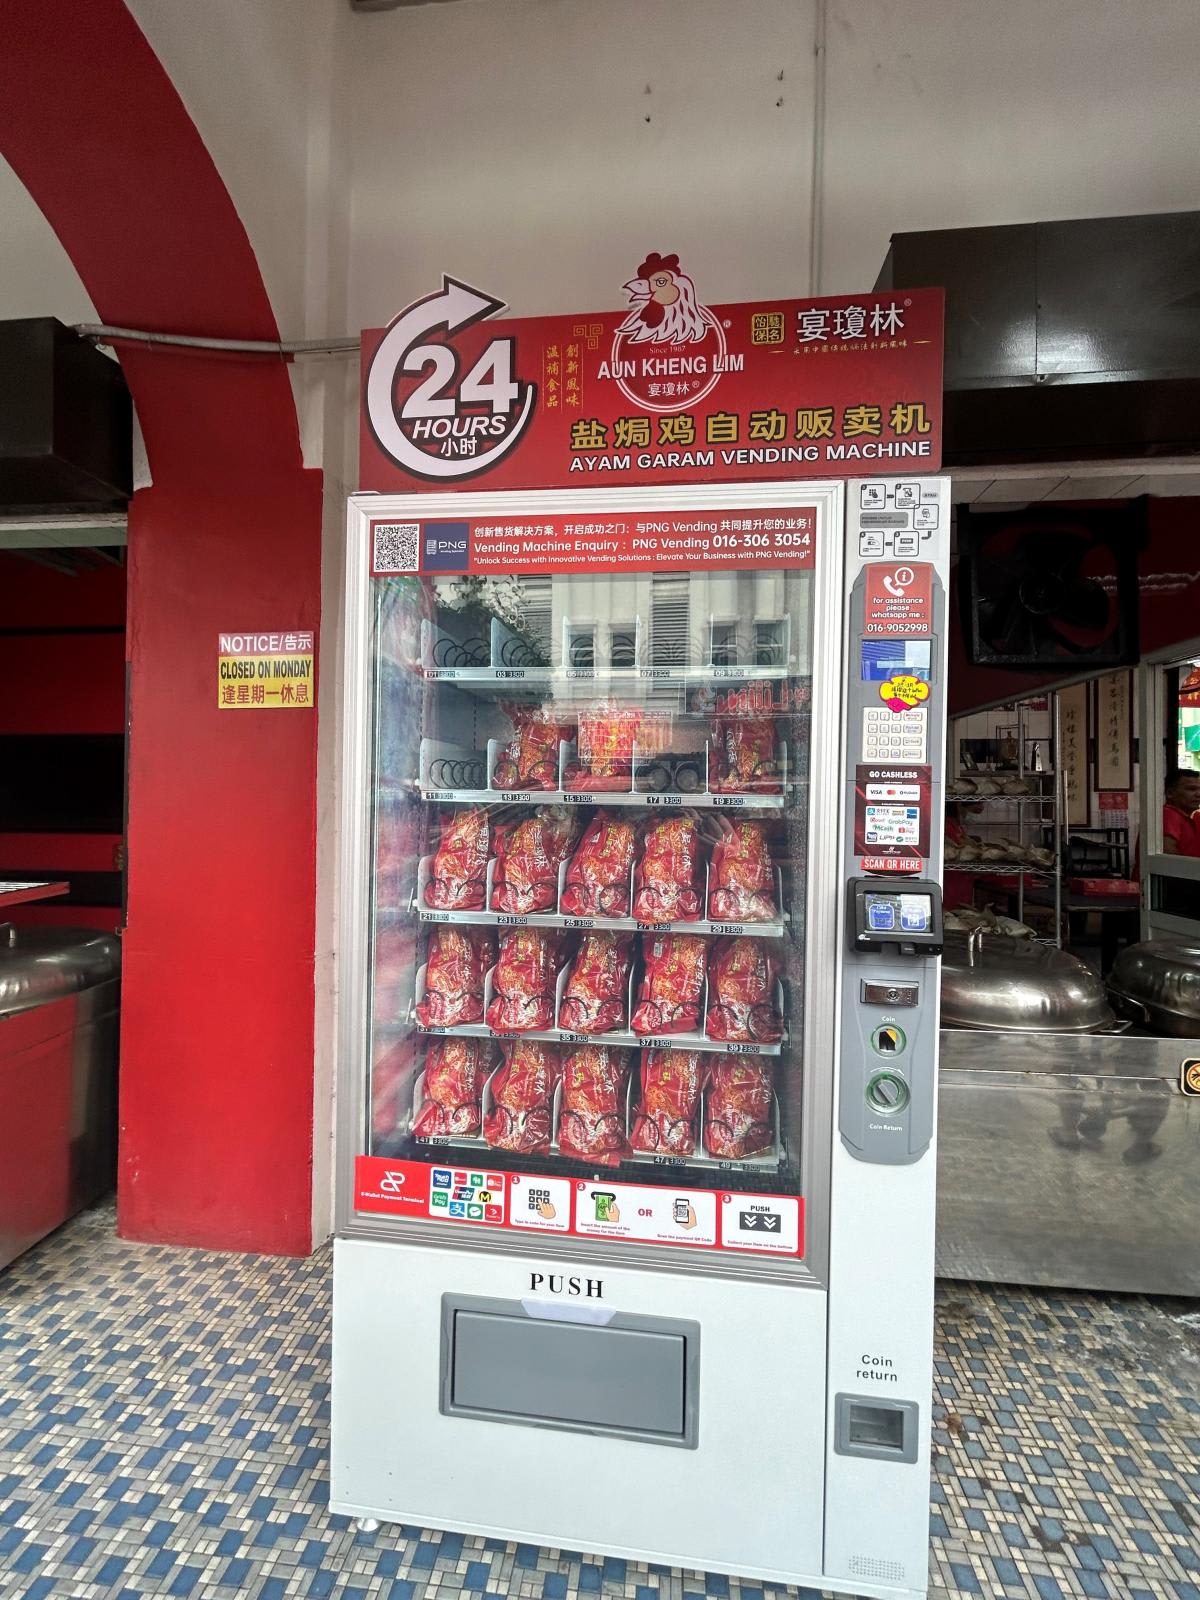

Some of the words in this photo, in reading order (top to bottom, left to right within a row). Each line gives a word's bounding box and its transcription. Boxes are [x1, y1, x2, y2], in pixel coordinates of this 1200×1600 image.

[597, 358, 636, 379] AUN
[641, 355, 707, 376] KHENG
[713, 354, 744, 372] LIM
[401, 340, 519, 419] 24
[412, 416, 507, 440] HOURS
[569, 403, 932, 451] 盐焗鸡自动贩卖机
[439, 437, 478, 456] 小时
[569, 455, 630, 473] AYAM
[636, 451, 715, 469] GARAM
[720, 445, 819, 464] VENDING
[825, 441, 931, 460] MACHINE
[672, 522, 718, 533] Vending
[439, 541, 467, 549] PNG
[474, 543, 520, 555] Vending
[523, 541, 571, 553] Machine
[574, 540, 619, 552] Enquiry
[632, 538, 658, 550] PNG
[661, 537, 710, 550] Vending
[713, 534, 770, 548] 016-306
[774, 533, 811, 546] 3054
[586, 555, 616, 563] Vending
[617, 554, 652, 562] Solutions
[656, 553, 684, 561] Elevate
[703, 552, 736, 560] Business
[737, 551, 754, 559] with
[867, 624, 928, 632] 016-9052998
[220, 661, 255, 679] CLOSED
[258, 661, 271, 678] ON
[274, 660, 311, 678] MONDAY
[222, 683, 309, 704] 逢星期一休息
[864, 859, 884, 869] SCAN
[900, 860, 920, 870] HERE
[637, 1208, 653, 1217] OR
[750, 1205, 771, 1213] PUSH
[529, 1272, 604, 1299] PUSH
[861, 1354, 893, 1367] Coin
[856, 1370, 898, 1382] return
